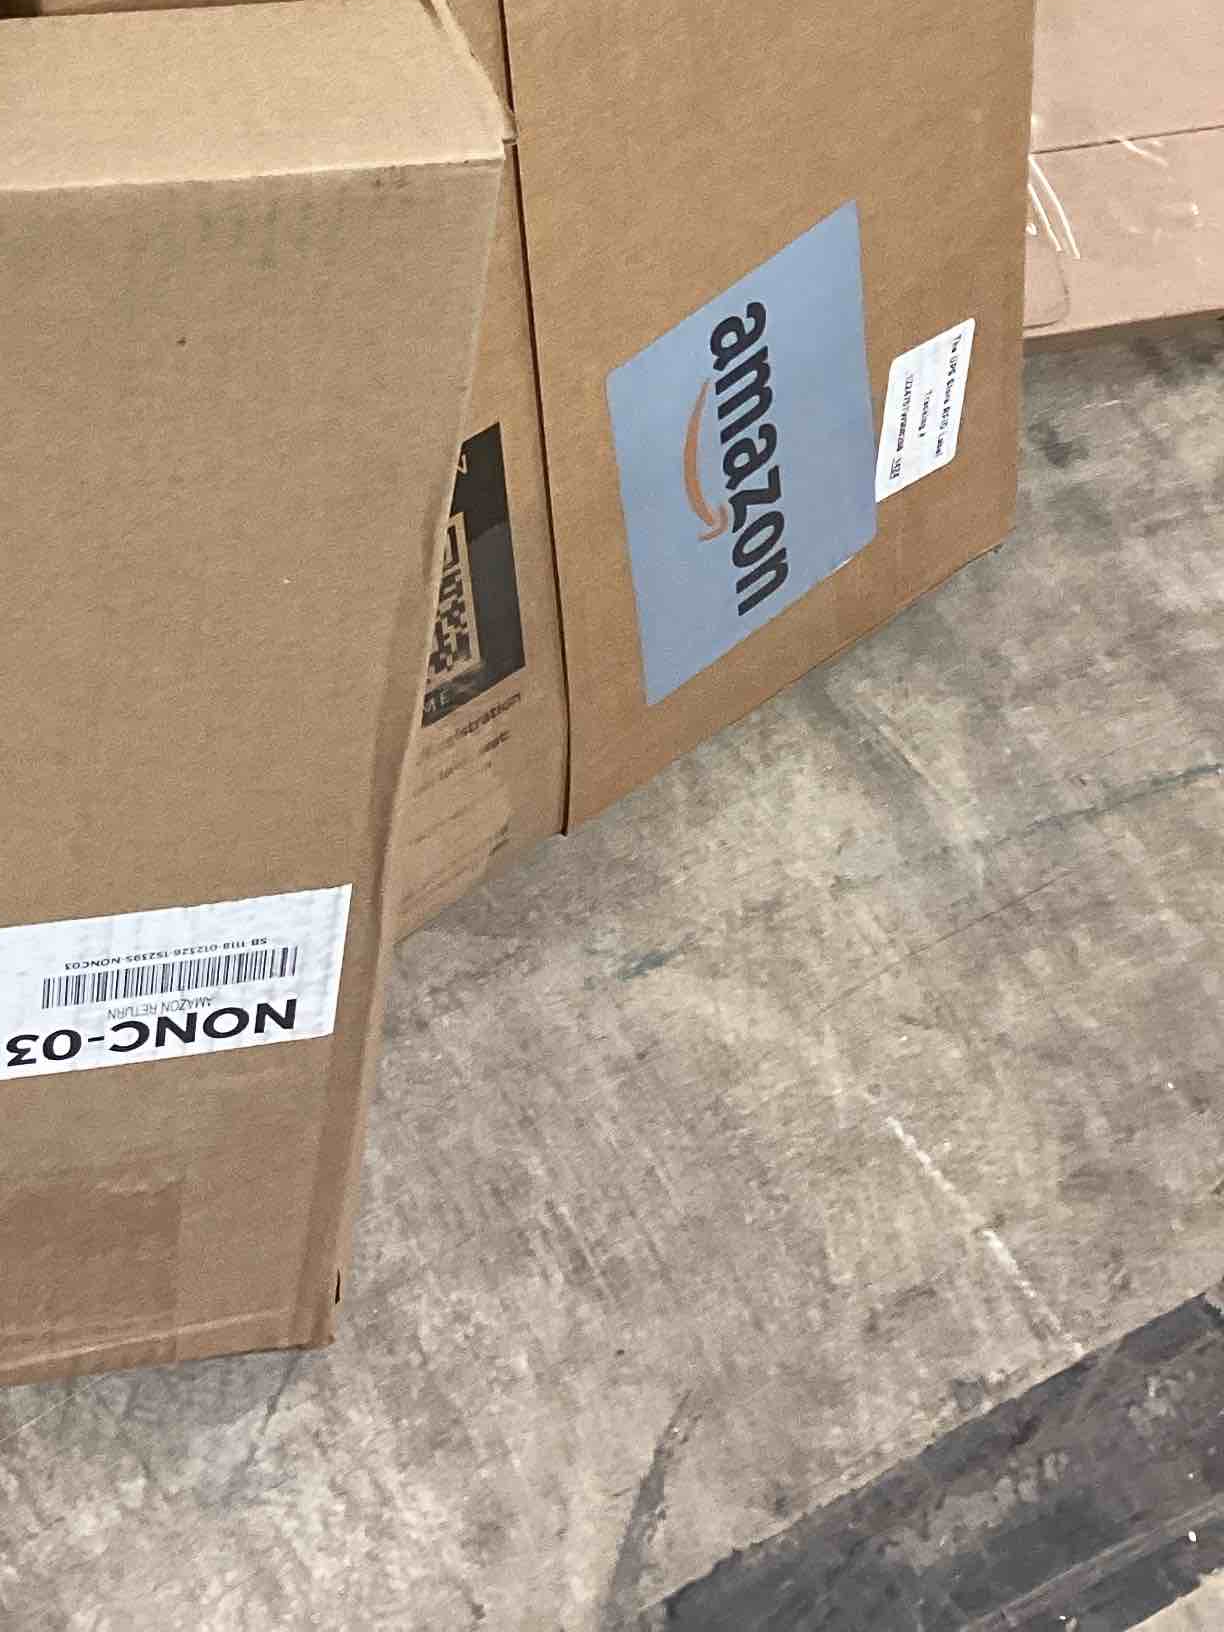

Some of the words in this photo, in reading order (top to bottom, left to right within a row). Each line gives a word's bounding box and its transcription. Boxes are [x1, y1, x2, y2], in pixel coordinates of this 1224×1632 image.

[708, 301, 792, 616] amazon
[106, 1002, 157, 1020] RETURN
[159, 995, 214, 1014] AMAZON
[5, 998, 298, 1067] NONC-03
